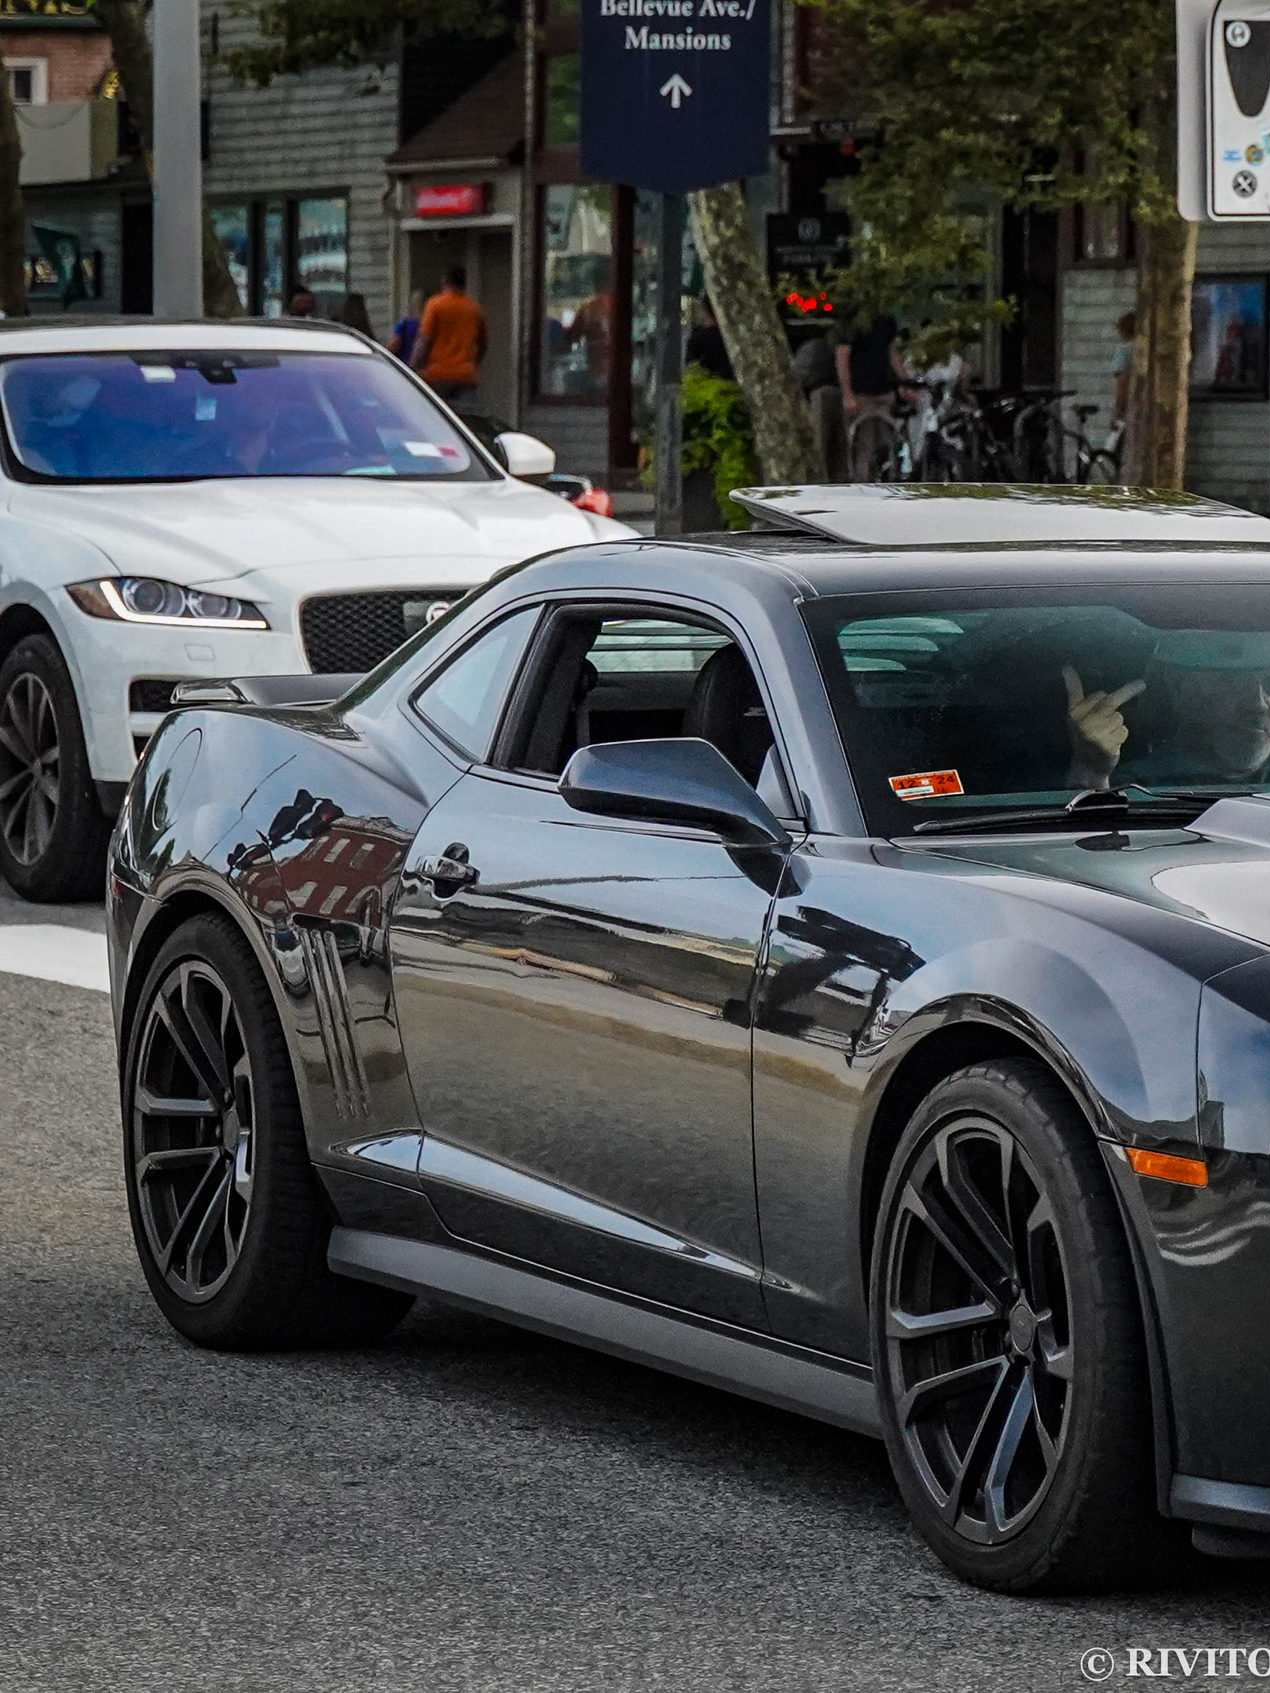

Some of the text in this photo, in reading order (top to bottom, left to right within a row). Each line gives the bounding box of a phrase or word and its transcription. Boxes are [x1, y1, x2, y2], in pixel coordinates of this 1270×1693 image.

[601, 0, 693, 17] Bellevue
[625, 26, 732, 50] Mansions
[898, 780, 915, 789] 12
[937, 775, 955, 785] 24
